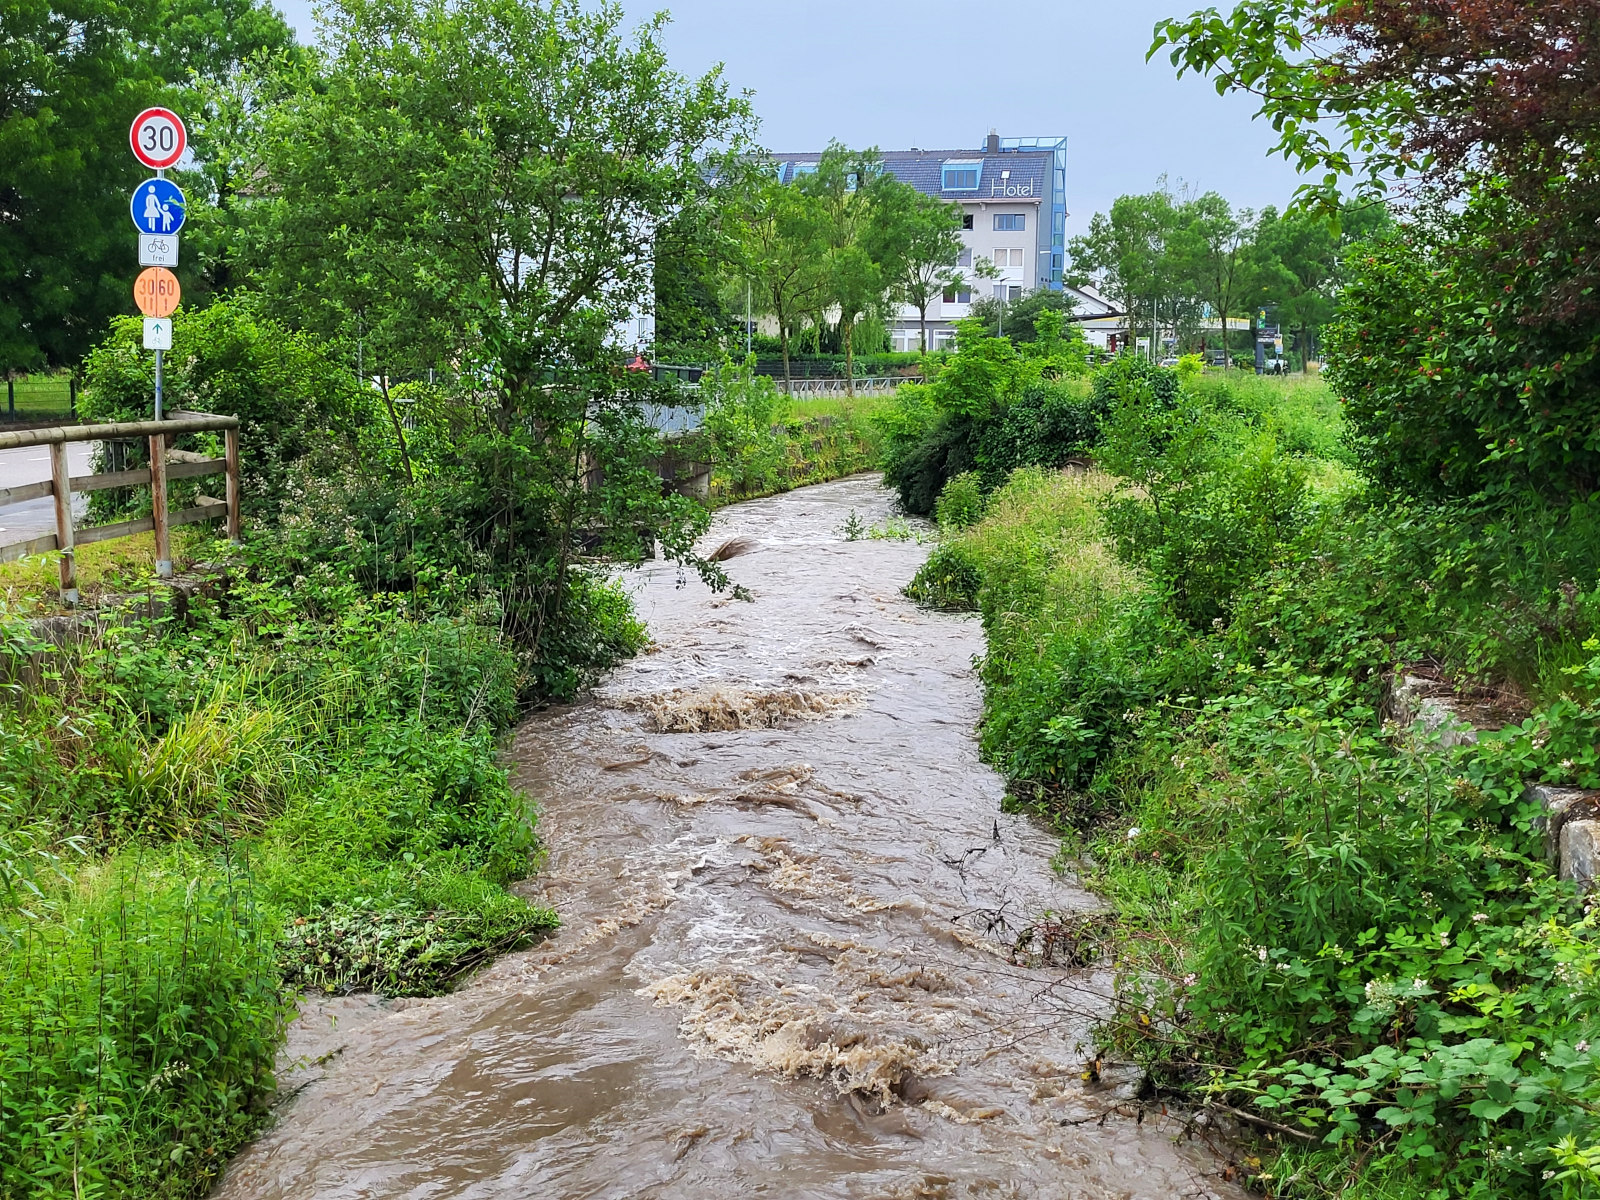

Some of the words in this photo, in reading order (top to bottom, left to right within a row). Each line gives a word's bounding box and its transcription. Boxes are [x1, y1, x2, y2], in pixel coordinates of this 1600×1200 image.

[143, 125, 173, 151] 30
[991, 177, 1033, 196] Hotel
[152, 254, 165, 262] frei
[139, 279, 155, 296] 30
[158, 279, 174, 296] 60
